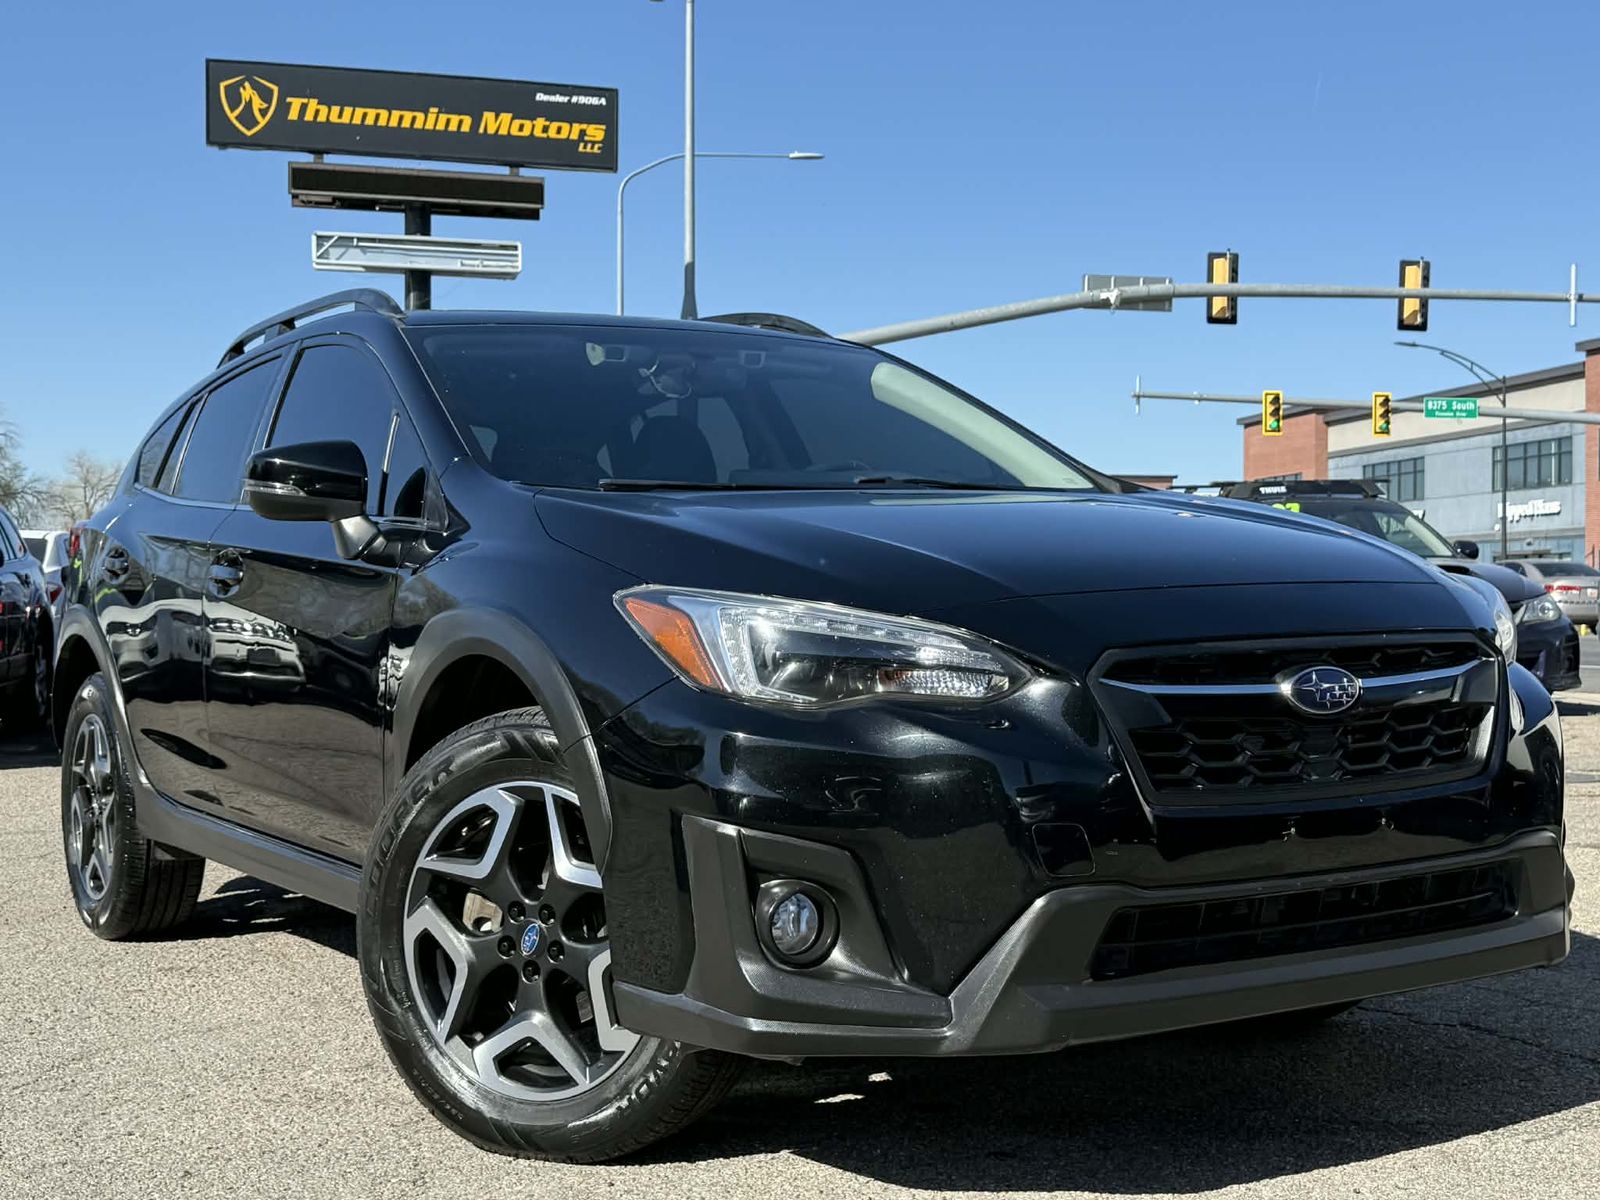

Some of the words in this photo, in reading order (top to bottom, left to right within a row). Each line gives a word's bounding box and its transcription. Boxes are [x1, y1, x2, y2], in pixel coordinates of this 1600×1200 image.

[535, 92, 570, 103] Dealer
[571, 95, 607, 106] #906A
[286, 96, 471, 133] Thummim
[478, 111, 607, 142] Motors
[578, 142, 603, 153] LLC
[1452, 400, 1475, 410] South
